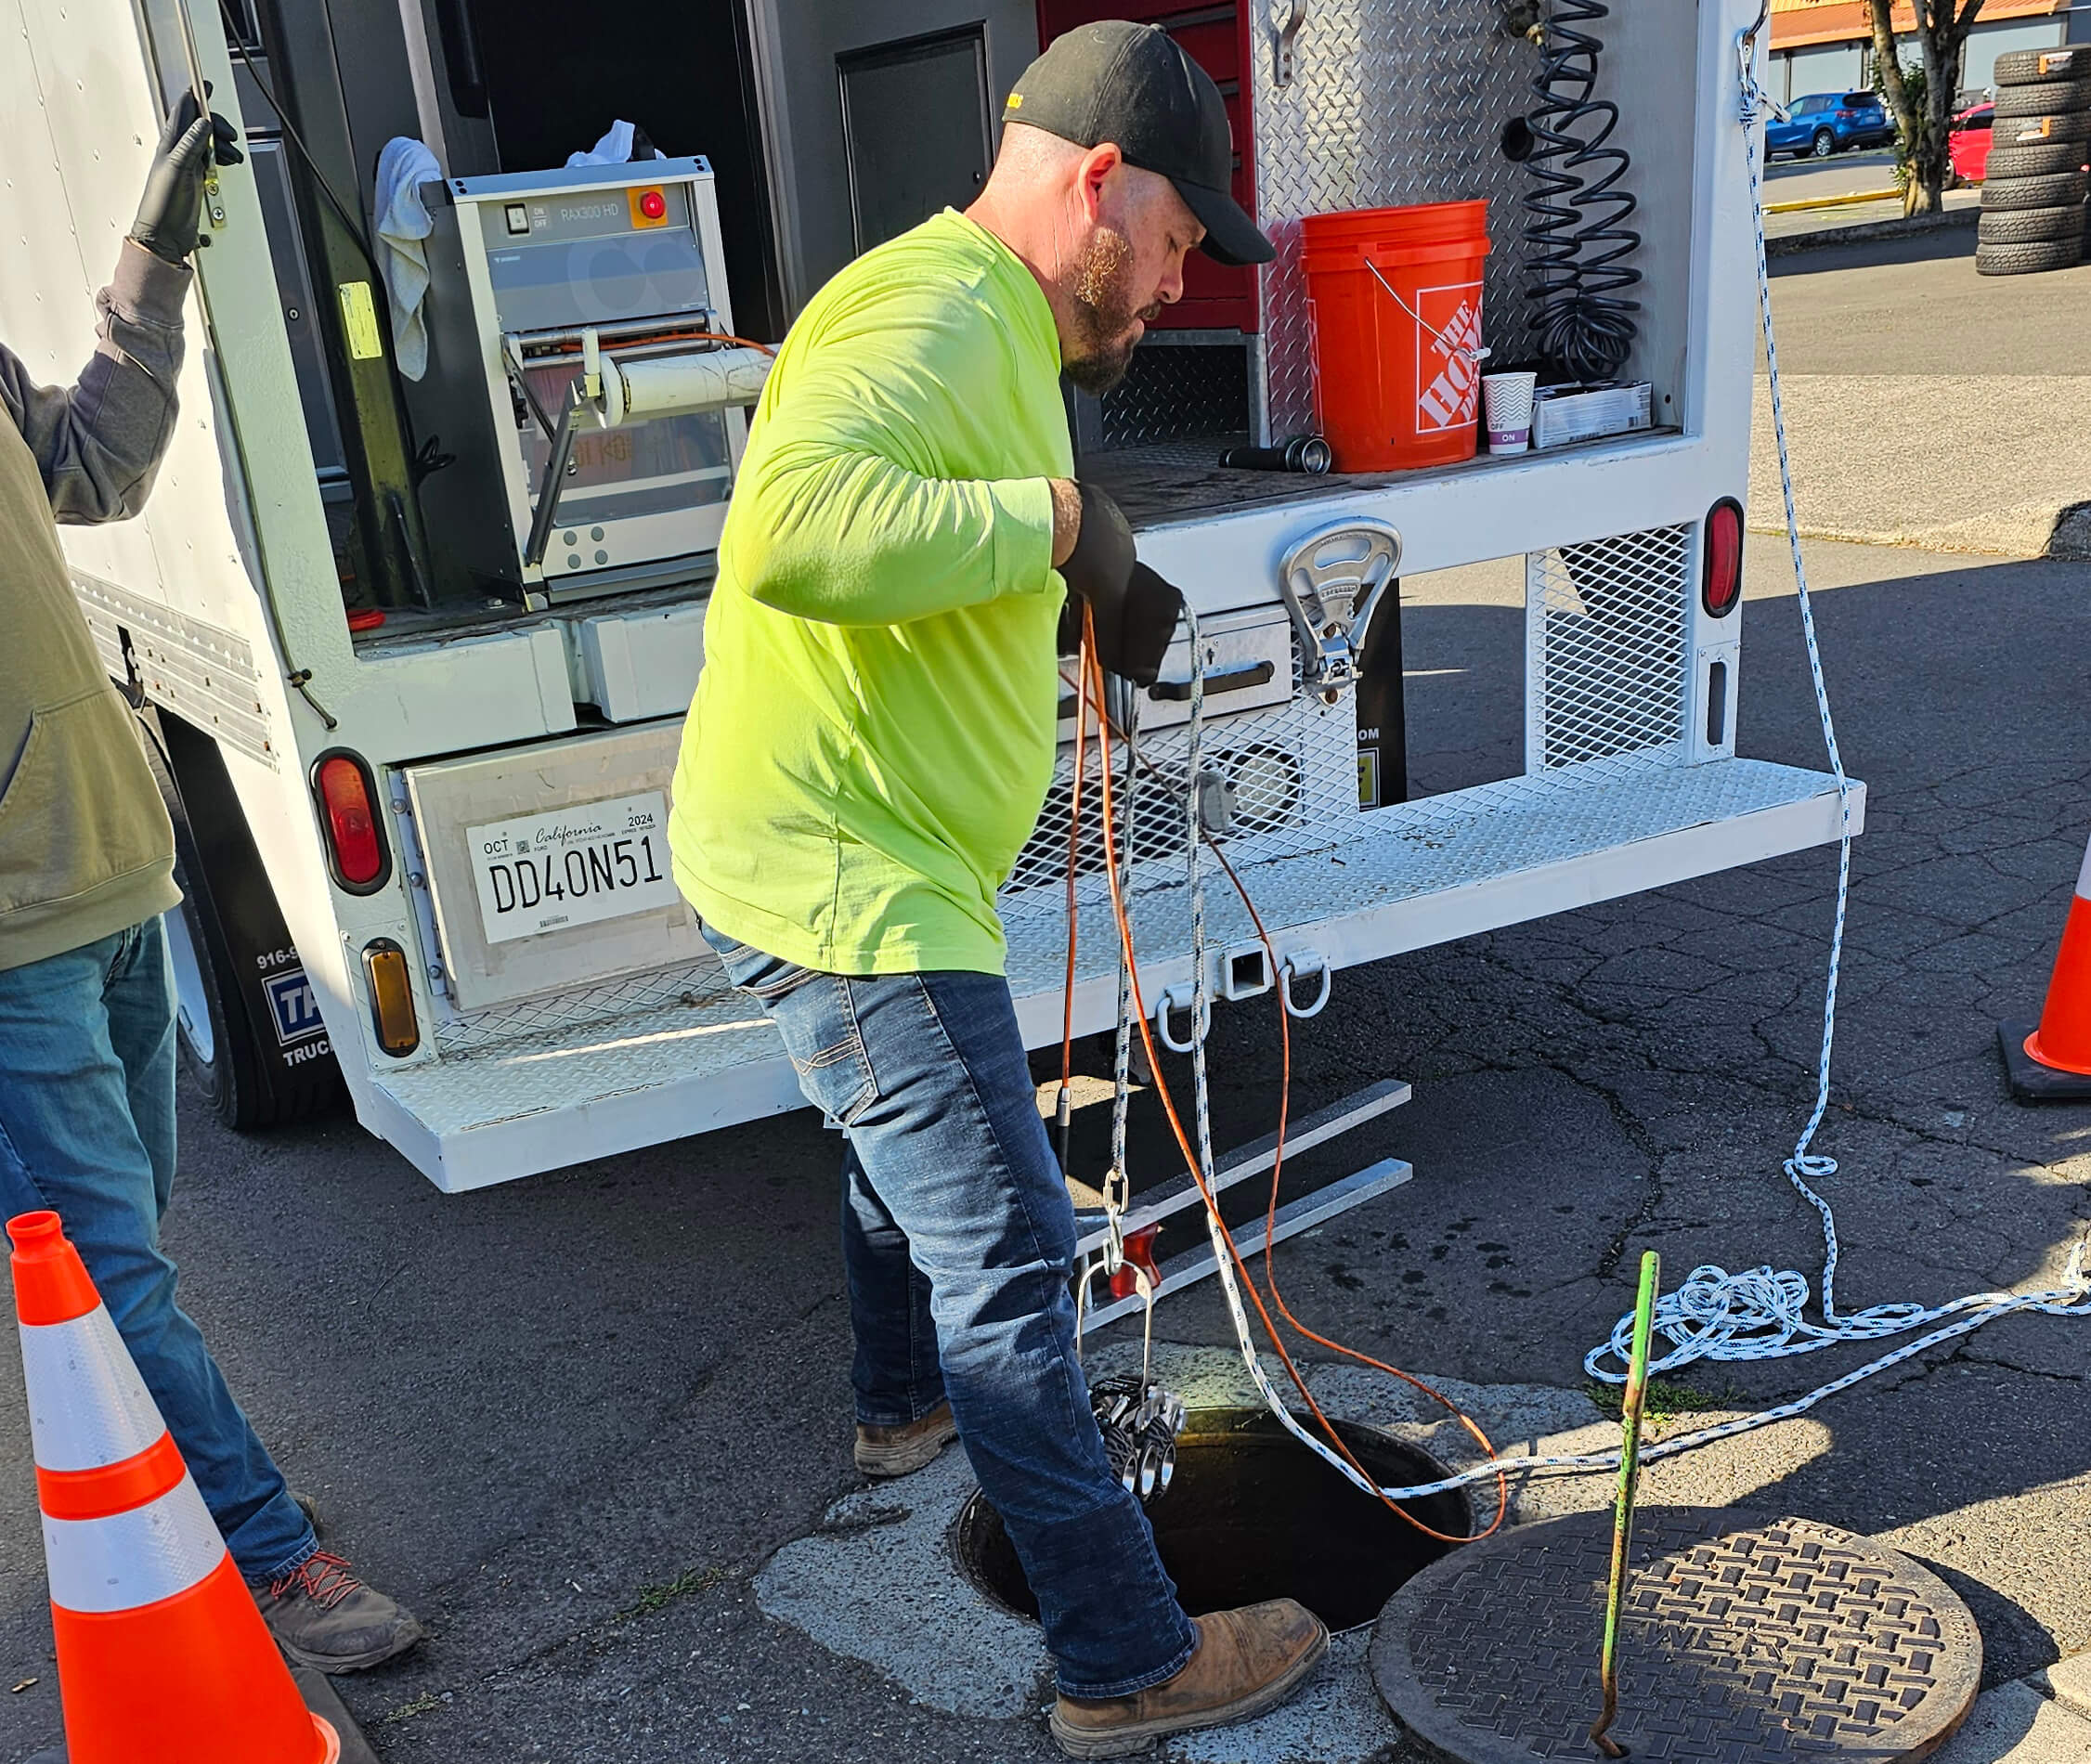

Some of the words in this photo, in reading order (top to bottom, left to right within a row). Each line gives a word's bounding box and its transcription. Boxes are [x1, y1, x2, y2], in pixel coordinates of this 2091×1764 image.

[561, 206, 602, 222] RAX300
[602, 203, 618, 216] HD
[1430, 299, 1474, 359] THE
[1418, 290, 1484, 430] HOM
[1490, 422, 1504, 431] OFF
[1501, 434, 1515, 442] ON
[628, 812, 654, 827] 2024
[536, 822, 603, 848] California
[483, 839, 509, 854] OCT
[256, 945, 299, 969] 916-9
[282, 1039, 334, 1067] TRUC
